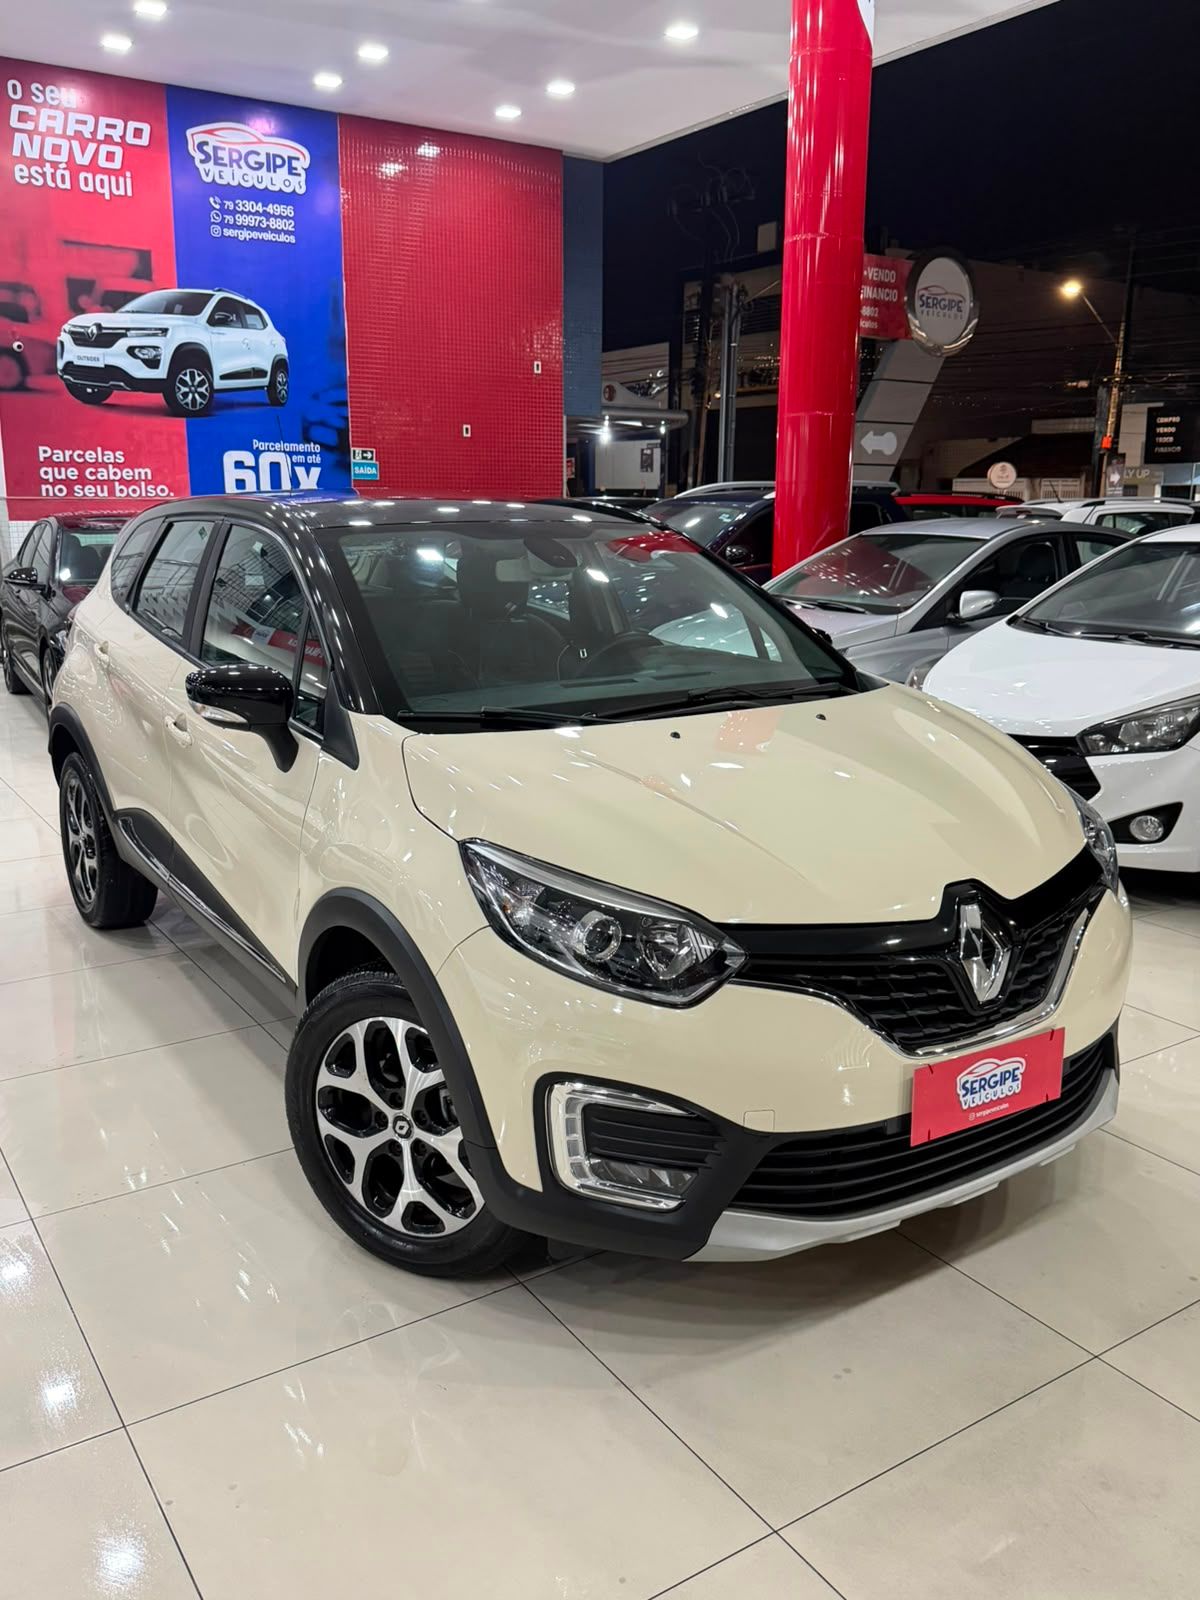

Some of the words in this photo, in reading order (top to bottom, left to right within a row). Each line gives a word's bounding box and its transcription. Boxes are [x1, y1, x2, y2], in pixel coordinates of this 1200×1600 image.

[30, 82, 77, 109] seu
[9, 103, 151, 147] CARRO
[12, 132, 123, 170] NOVO
[196, 140, 302, 177] SERGIPE
[14, 162, 71, 190] está
[78, 171, 133, 200] aqui
[223, 200, 234, 210] 79
[235, 199, 295, 218] 3304-4956
[223, 214, 234, 225] 79
[235, 213, 295, 232] 99973-8802
[222, 227, 296, 244] sergipeveiculos
[919, 294, 963, 312] SERGIPE
[38, 445, 125, 463] Parcelas
[252, 439, 321, 453] Parcelamento
[292, 454, 306, 464] em
[307, 453, 322, 464] até
[39, 466, 79, 483] que
[84, 464, 153, 481] cabem
[354, 465, 377, 475] SAÍDA
[40, 483, 68, 497] no
[73, 484, 109, 497] seu
[114, 481, 175, 498] bolso.
[961, 1067, 1019, 1097] SERGIPE
